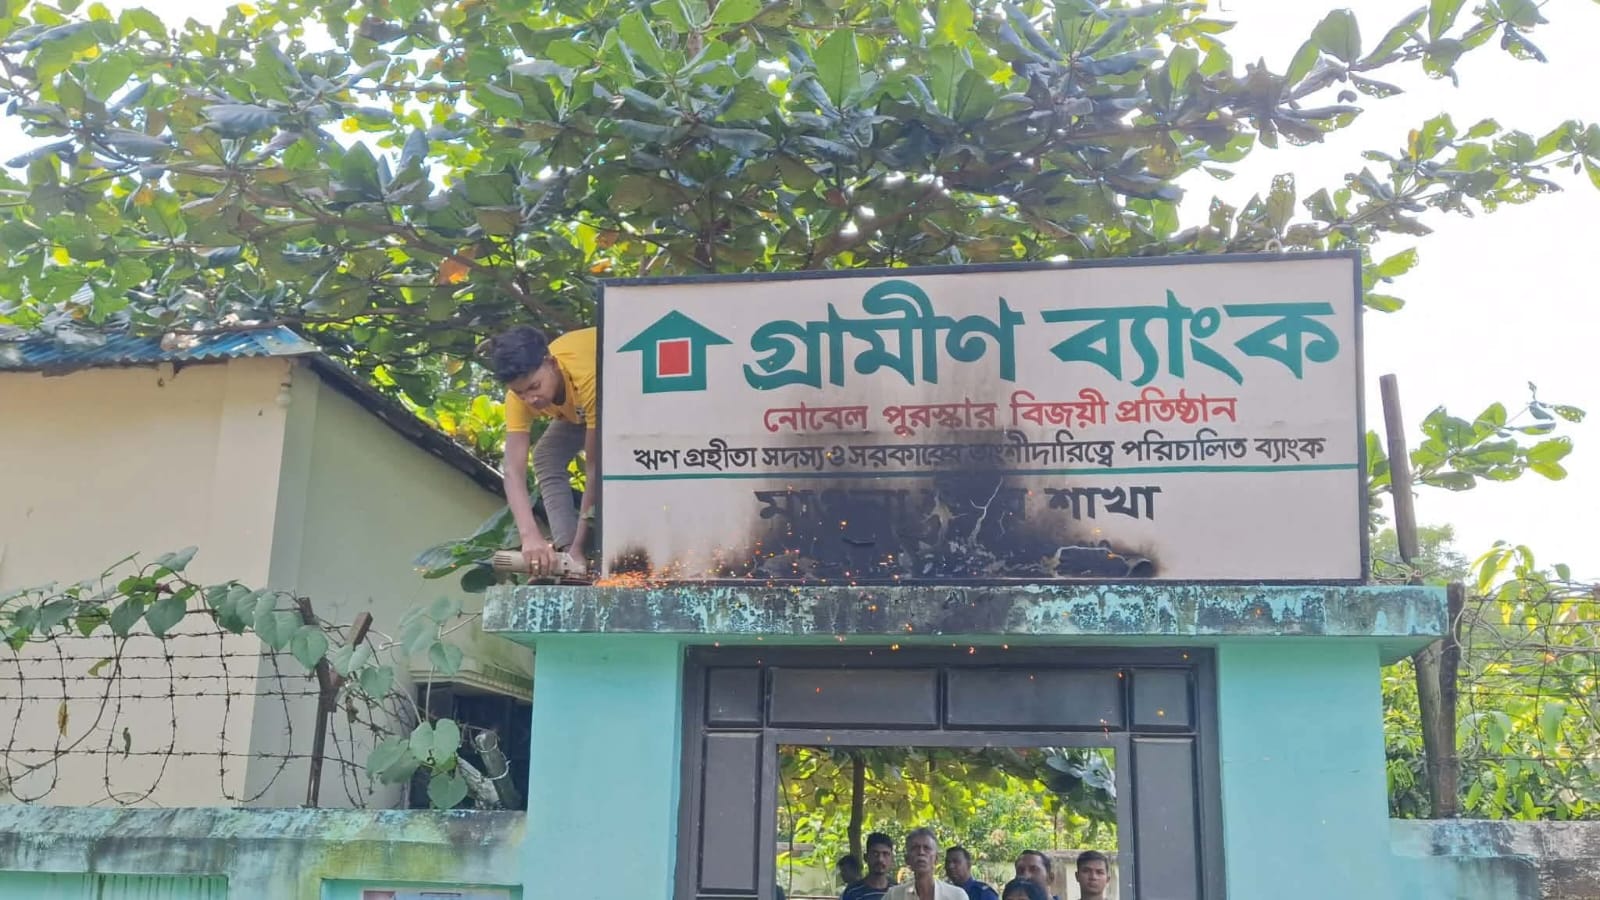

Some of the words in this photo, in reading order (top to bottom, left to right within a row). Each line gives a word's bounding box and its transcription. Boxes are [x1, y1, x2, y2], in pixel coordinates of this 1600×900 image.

[743, 279, 1024, 391] গ্রামীণ
[1041, 289, 1340, 387] ব্যাংক
[763, 401, 868, 433] নোবেল
[882, 397, 997, 436] পুরস্কার
[1009, 388, 1109, 428] বিজয়ী
[1115, 386, 1238, 425] প্রতিষ্ঠান
[633, 446, 679, 471] ঋণ
[683, 438, 757, 471] গ্রহীতা
[762, 445, 826, 471] সদস্য
[828, 445, 846, 468] ও
[1121, 427, 1248, 462] পরিচালিত
[1254, 436, 1326, 463] ব্যাংক
[1045, 485, 1162, 521] শাখা
